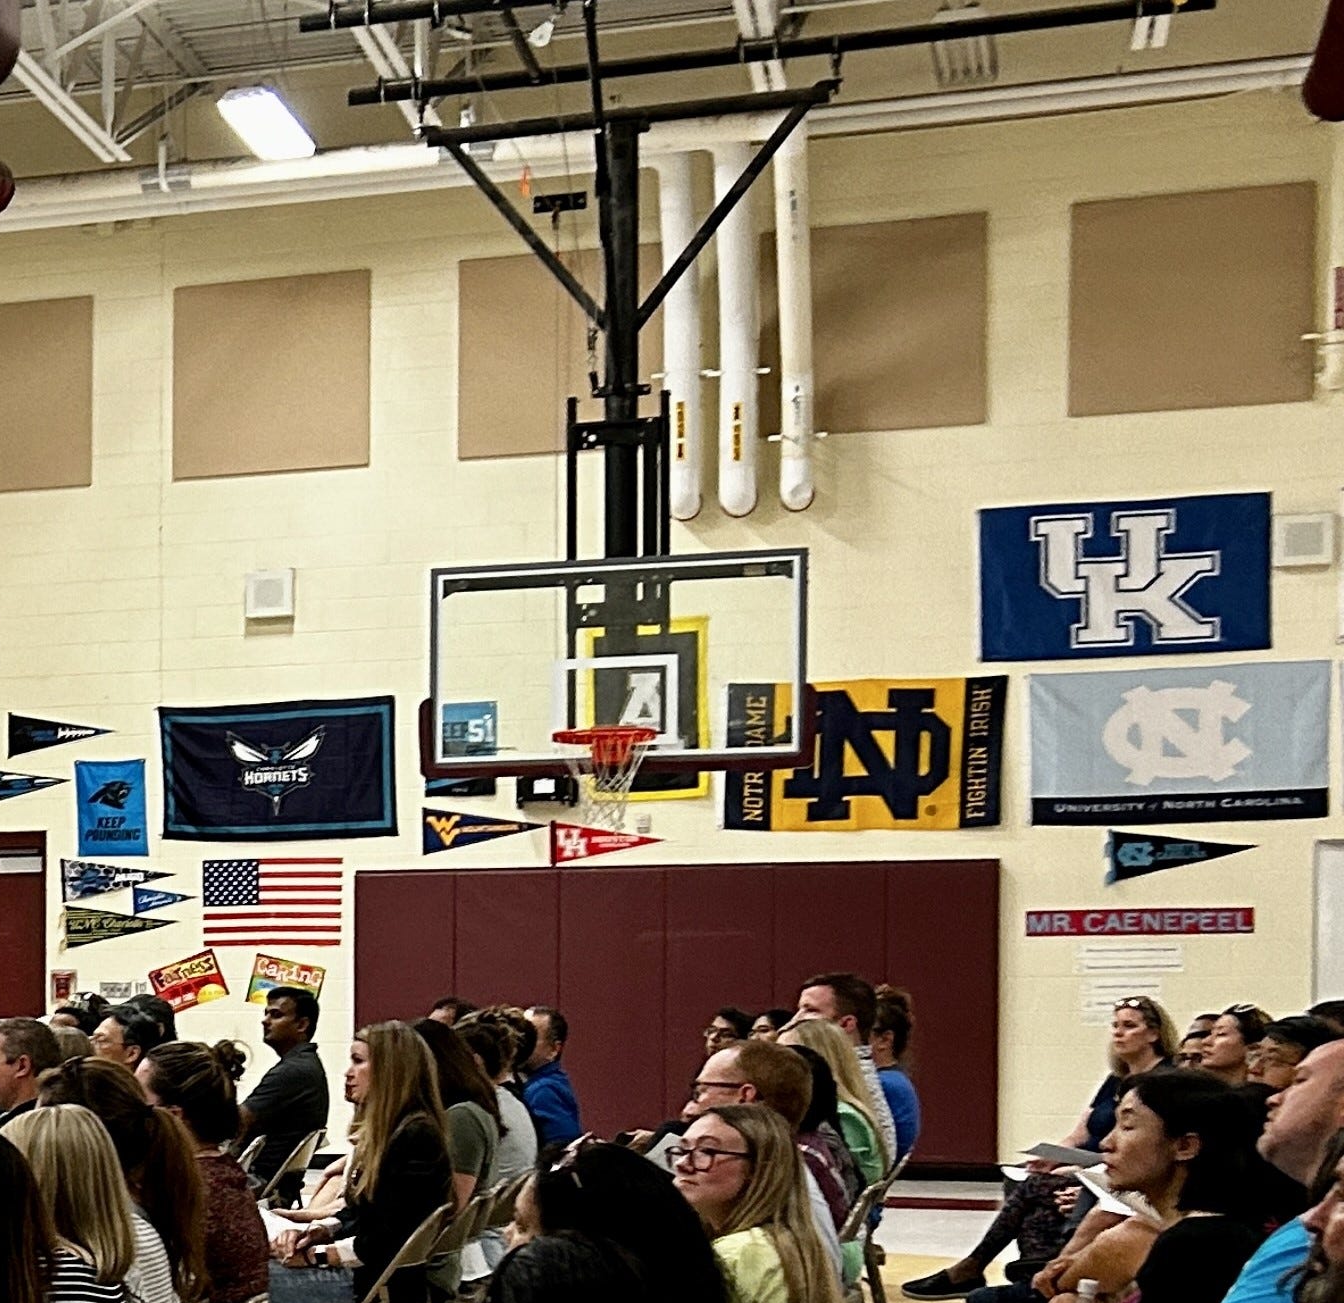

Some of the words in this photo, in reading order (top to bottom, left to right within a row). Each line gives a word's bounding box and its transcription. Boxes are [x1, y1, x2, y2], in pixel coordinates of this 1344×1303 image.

[970, 688, 993, 736] IRISH
[244, 767, 309, 786] HORNETS
[743, 771, 765, 822] NOTR
[97, 816, 127, 829] KEEP
[84, 827, 142, 842] POUNDING
[1026, 914, 1077, 934] MR.
[1082, 911, 1253, 933] CAENEPEEL
